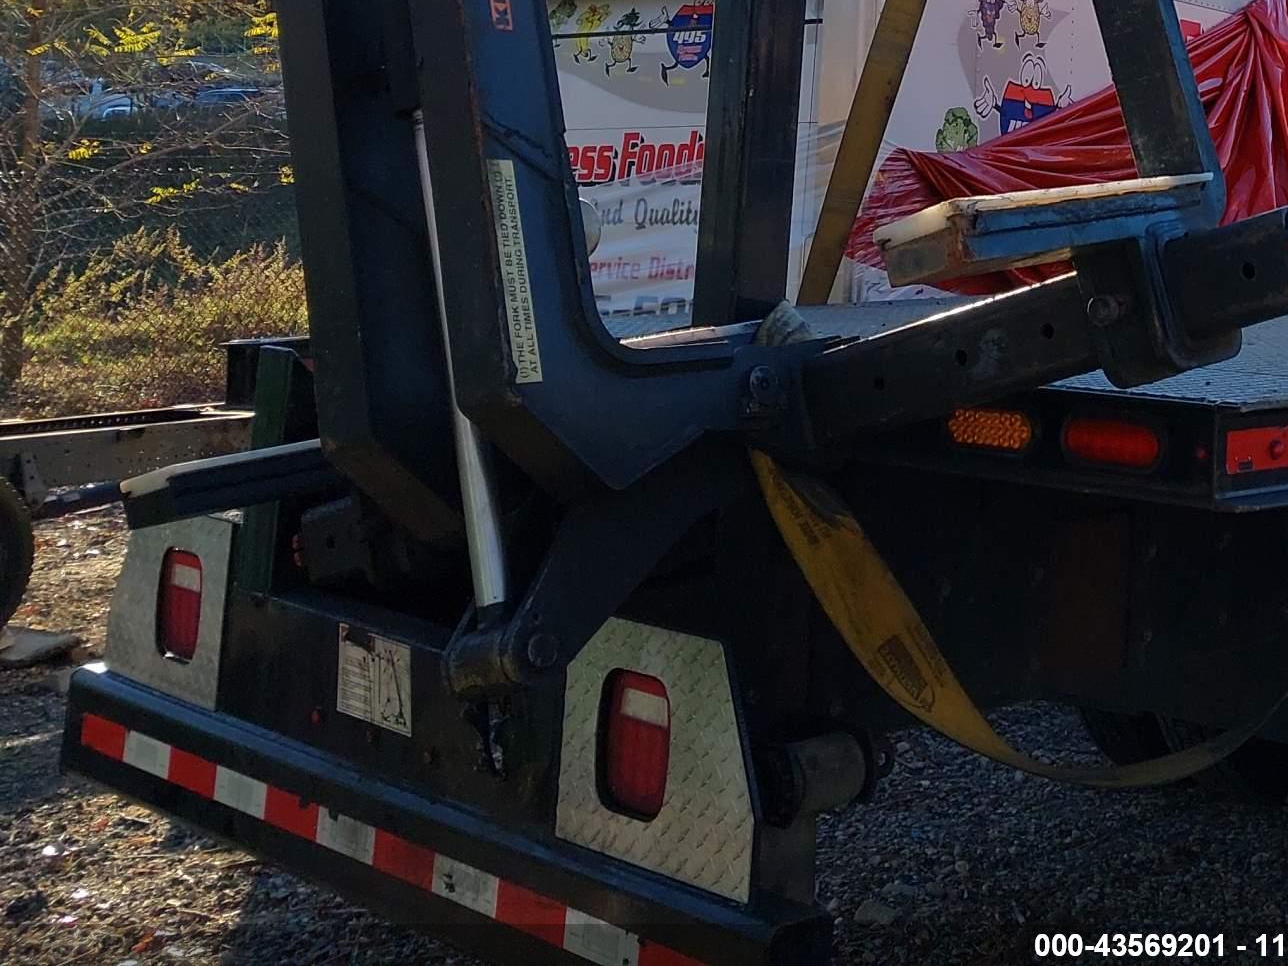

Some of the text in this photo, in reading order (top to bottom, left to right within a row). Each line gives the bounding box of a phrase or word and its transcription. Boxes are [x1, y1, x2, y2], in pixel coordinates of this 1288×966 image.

[672, 30, 707, 44] 495
[567, 130, 704, 183] ess Food
[497, 181, 507, 217] DOWN
[501, 220, 511, 248] TIED
[505, 250, 513, 267] BE
[591, 255, 695, 280] ervice Distr
[505, 177, 539, 373] AT ALL TIMES DURING TRANSPORT
[507, 271, 519, 302] MUST
[512, 309, 523, 339] FORK
[515, 341, 527, 365] THE
